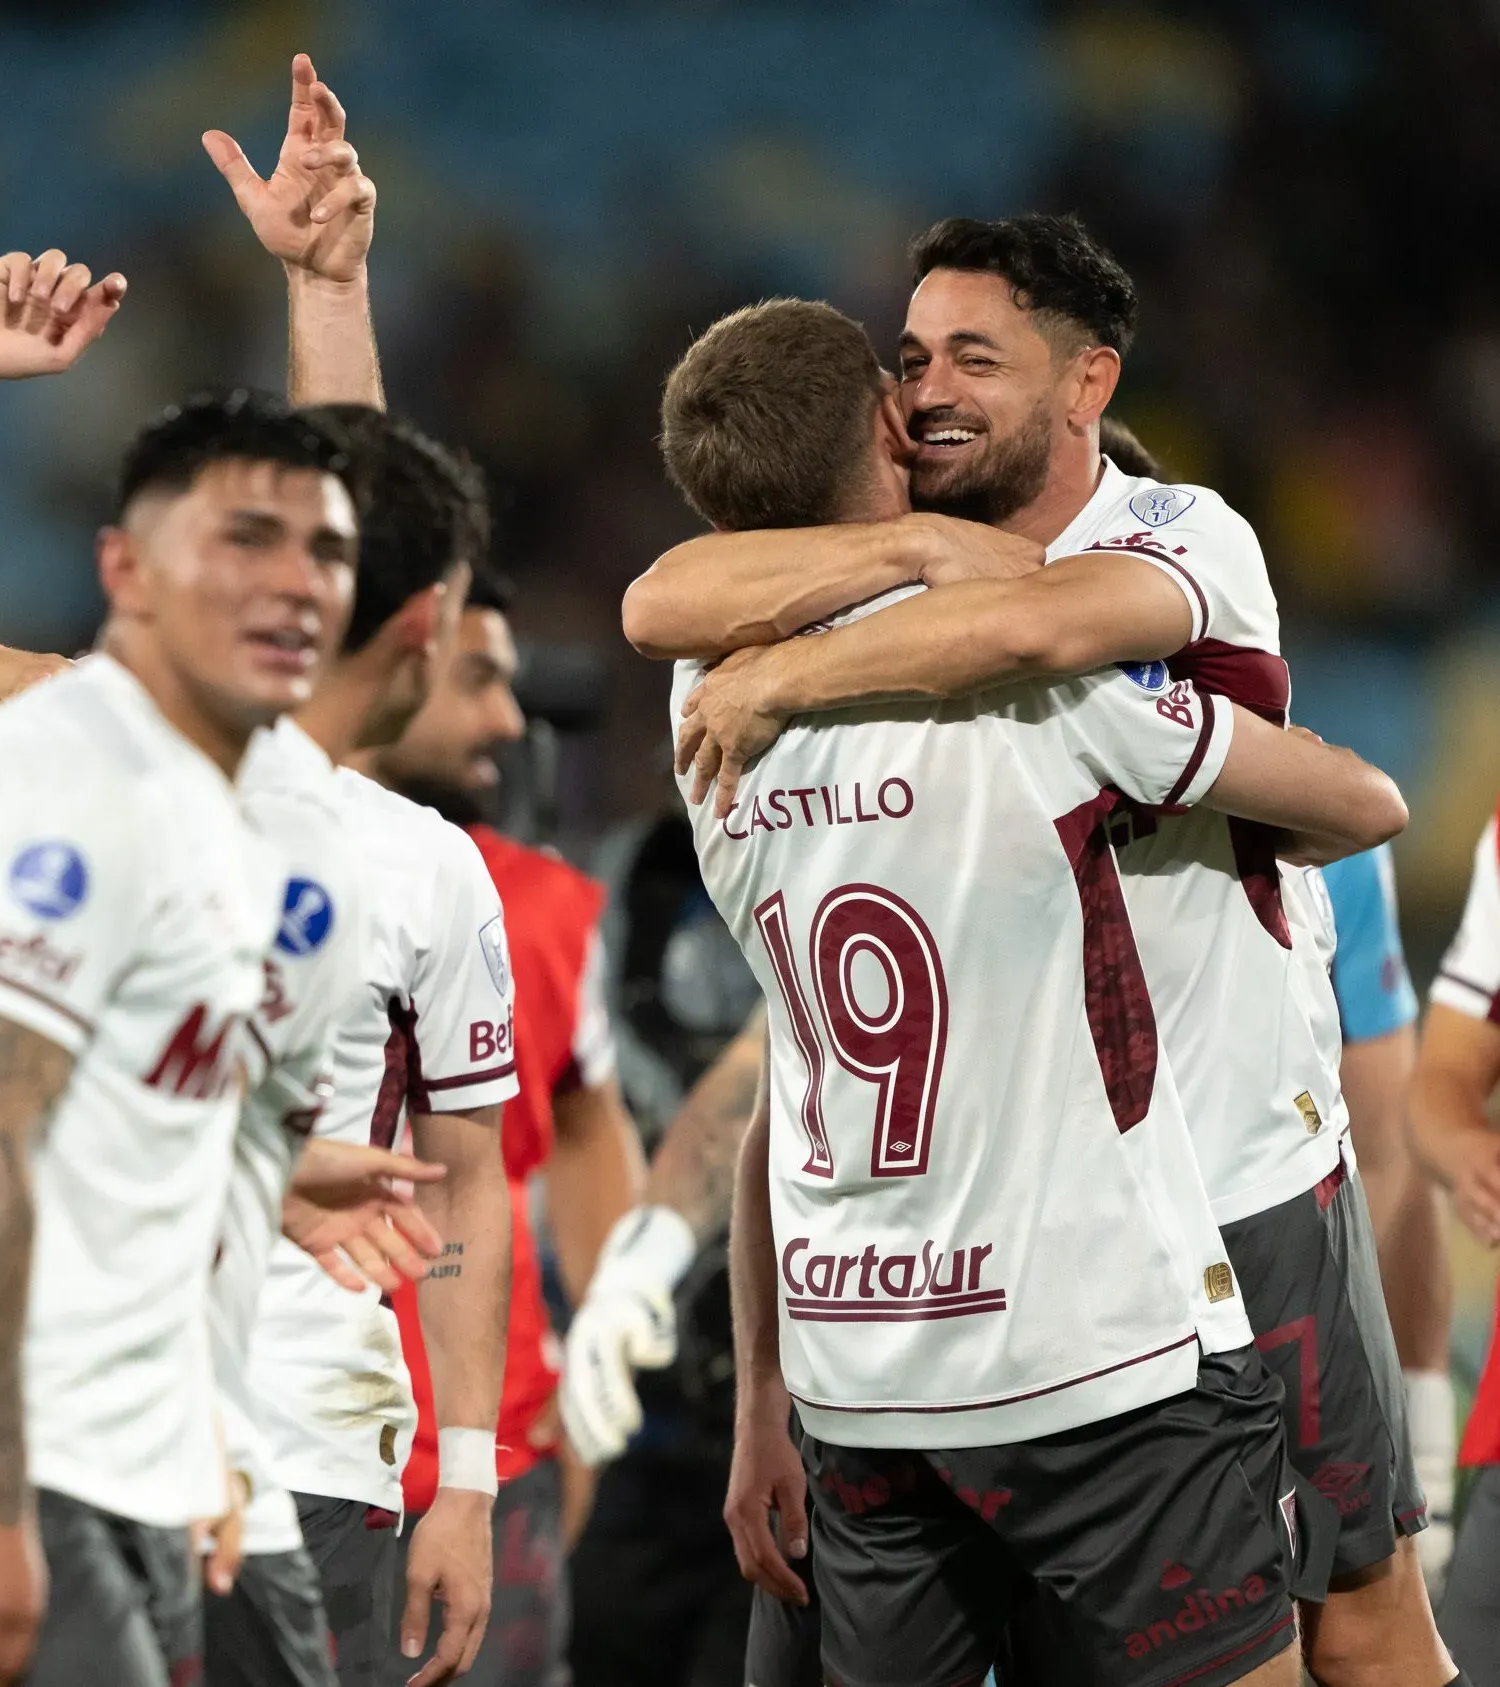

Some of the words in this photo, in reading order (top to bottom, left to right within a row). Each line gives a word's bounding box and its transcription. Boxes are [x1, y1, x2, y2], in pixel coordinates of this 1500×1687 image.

[721, 776, 914, 841] CASTILLO
[140, 1000, 233, 1101] M
[753, 882, 950, 1179] 19
[781, 1237, 993, 1299] CartaSur
[1253, 1313, 1321, 1448] 7
[1124, 1574, 1266, 1660] andina
